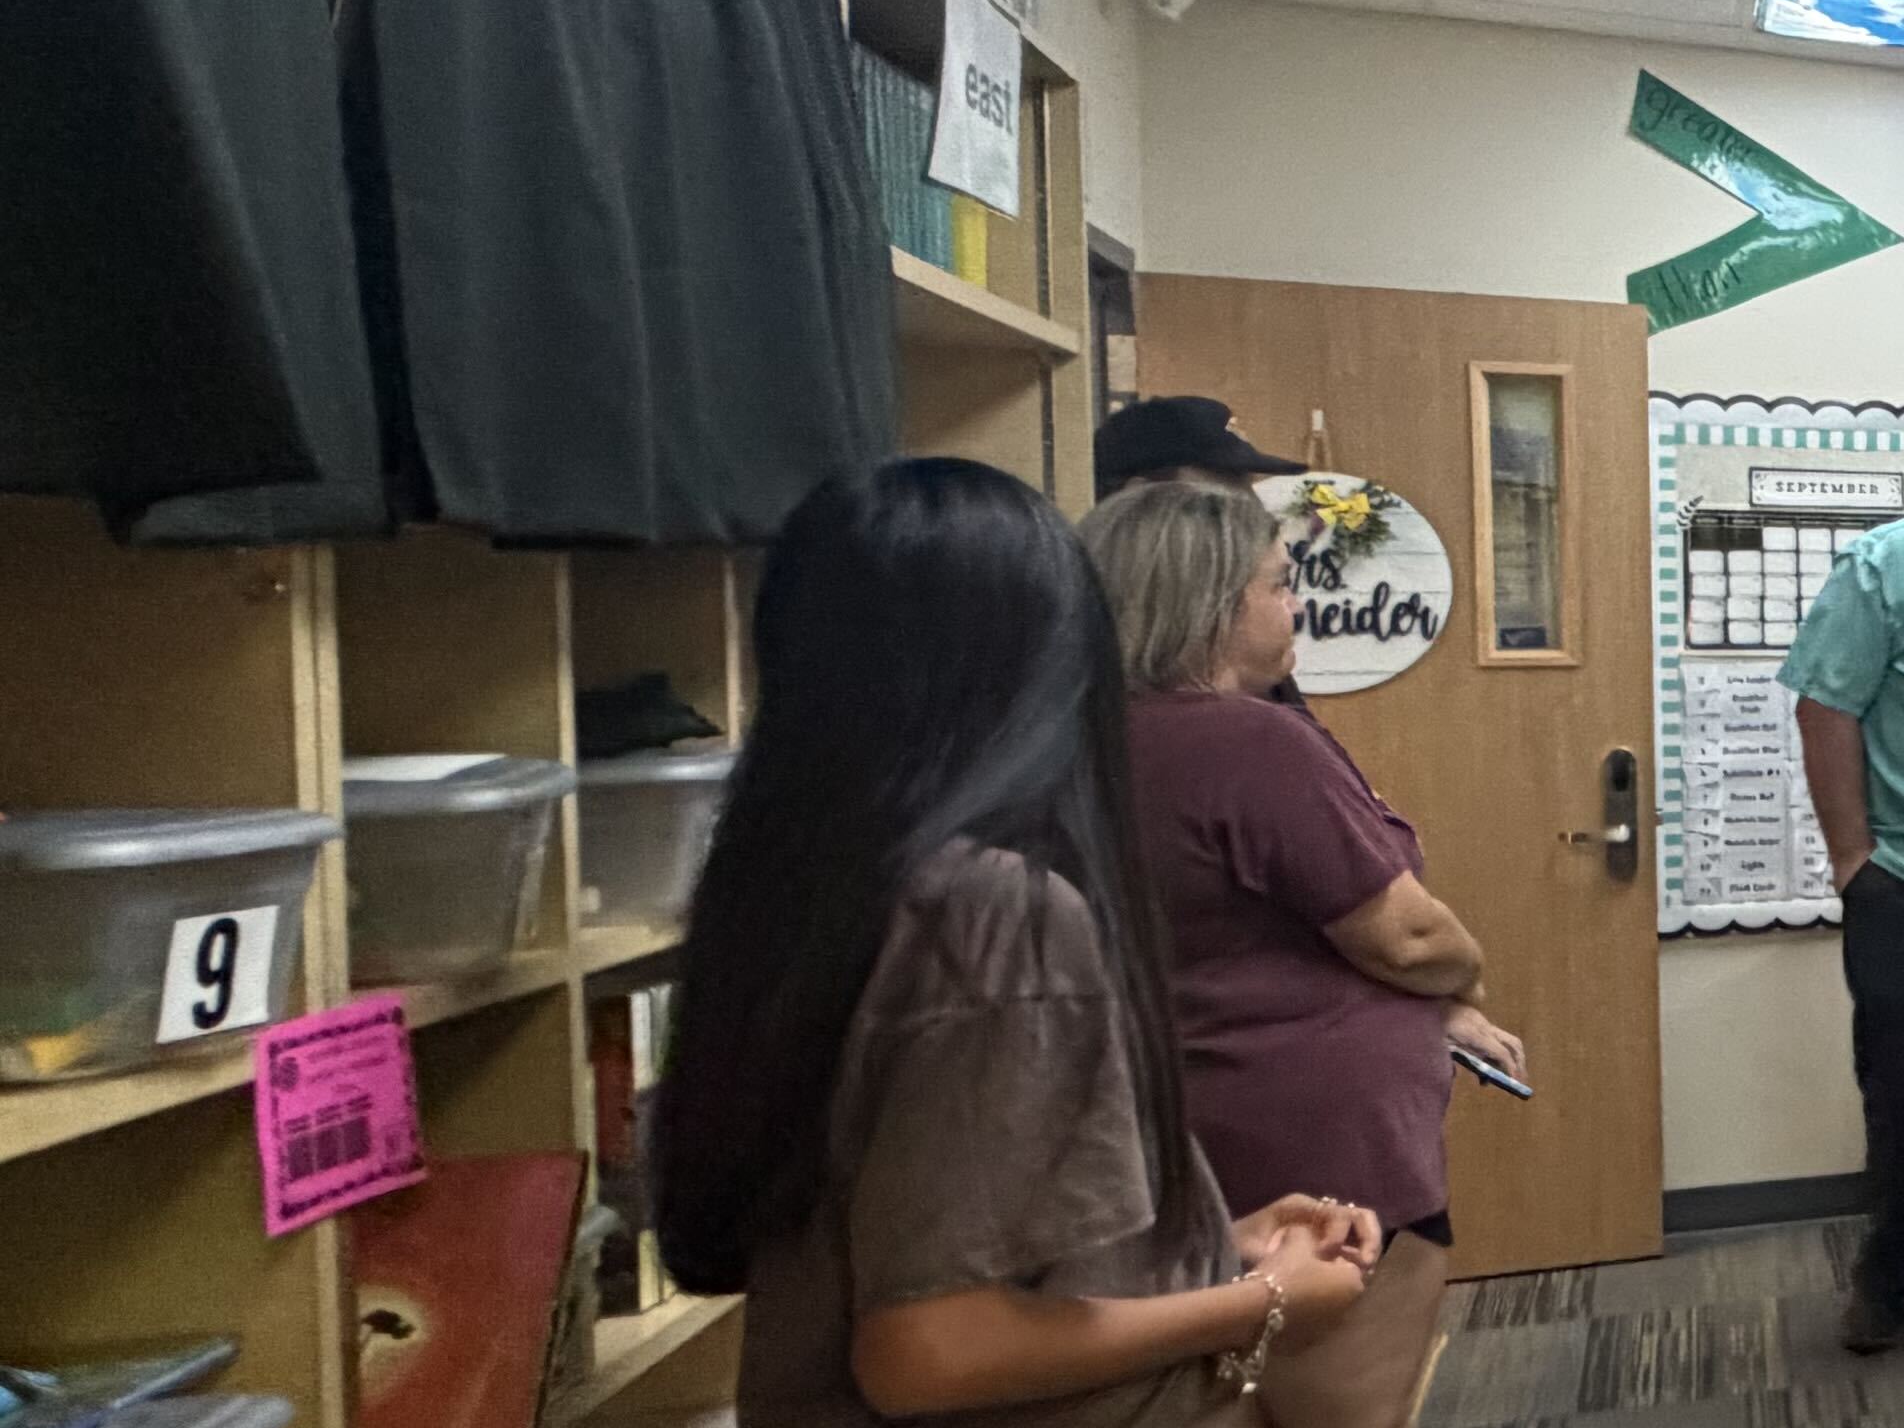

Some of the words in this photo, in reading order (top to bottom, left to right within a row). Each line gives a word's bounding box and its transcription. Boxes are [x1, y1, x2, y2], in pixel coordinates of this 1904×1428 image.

[965, 63, 1012, 135] east
[1775, 481, 1880, 495] SEPTEMBER
[191, 917, 240, 1030] 9
